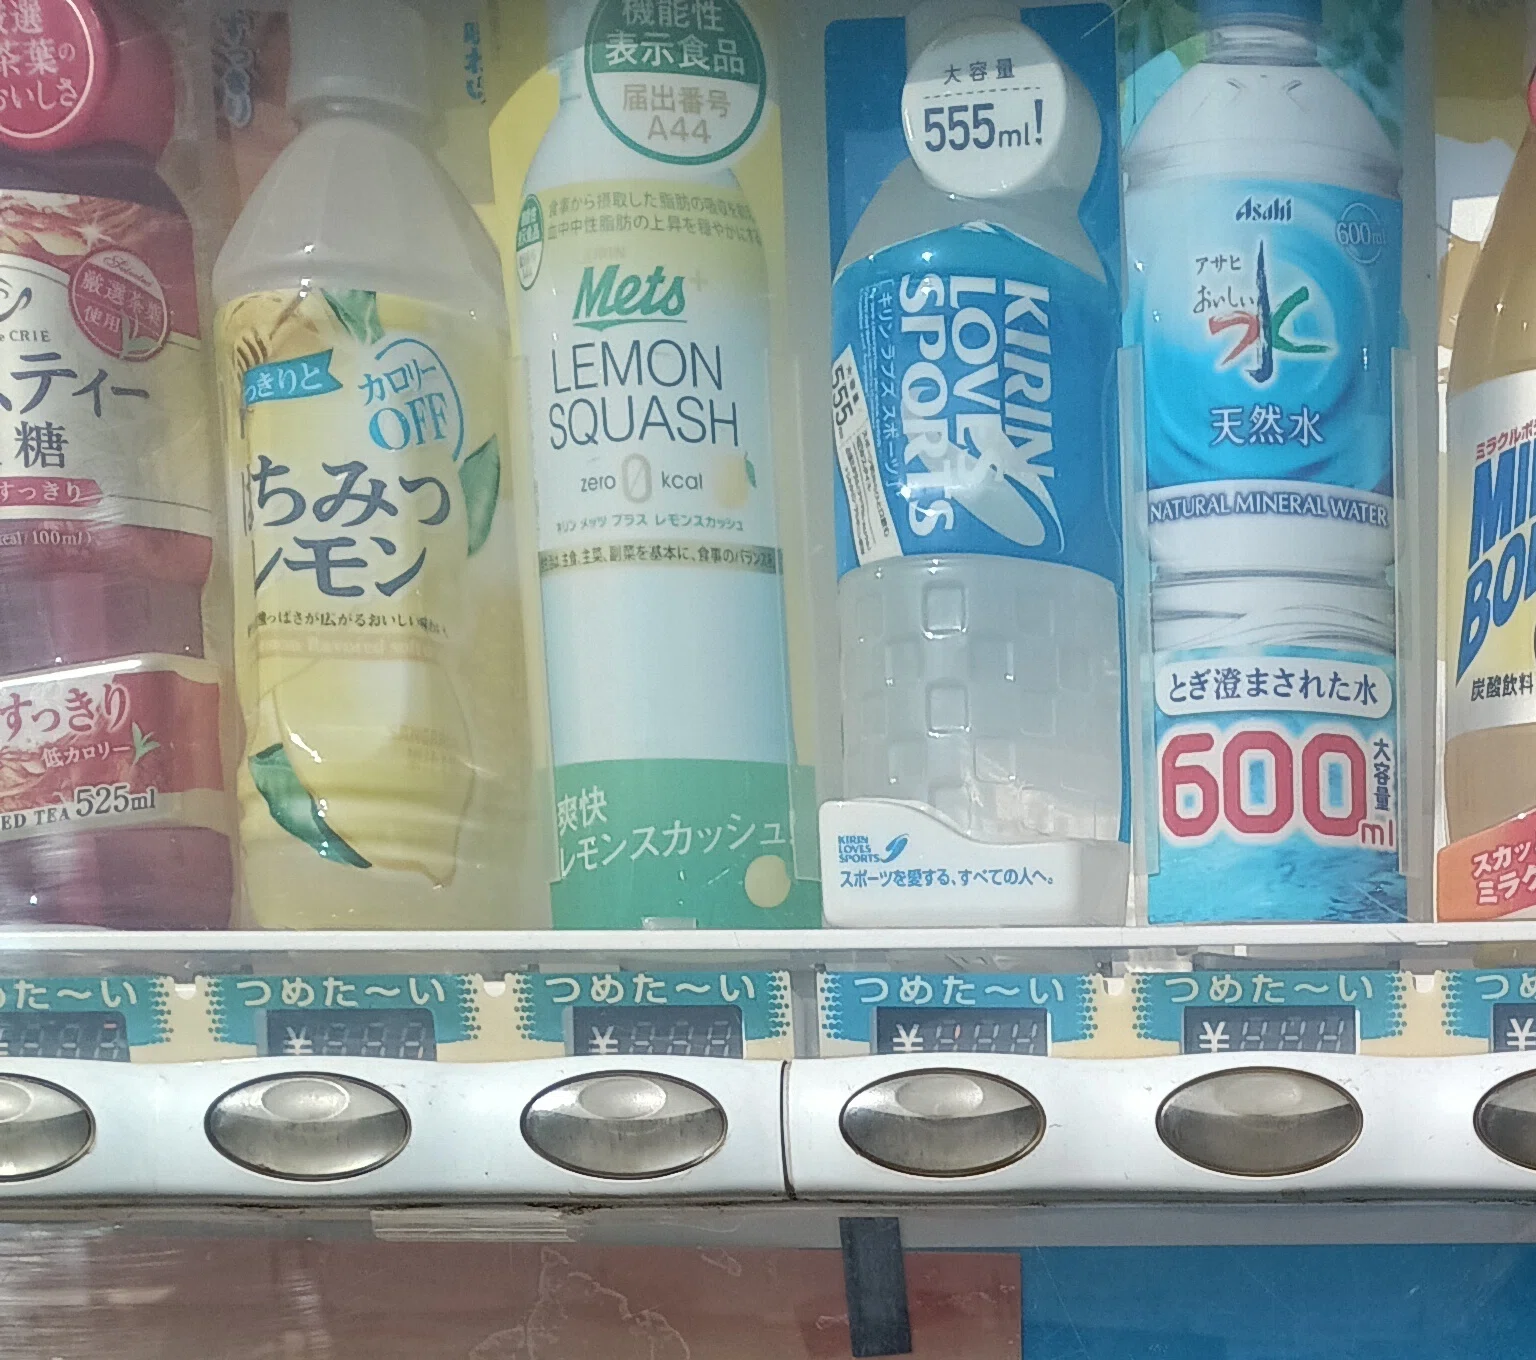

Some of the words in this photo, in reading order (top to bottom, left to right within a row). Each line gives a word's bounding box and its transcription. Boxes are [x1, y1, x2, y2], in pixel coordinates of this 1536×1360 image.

[605, 30, 745, 75] 表示食品
[943, 58, 1015, 84] 大容量
[647, 115, 712, 144] A44
[1235, 197, 1292, 222] Asahi
[1195, 254, 1242, 272] アサヒ
[572, 263, 686, 320] Mets
[551, 340, 724, 393] LEMON
[368, 392, 449, 451] OFF
[549, 395, 739, 450] SQUASH
[1210, 406, 1324, 448] 天然水
[580, 475, 616, 493] zero
[661, 471, 704, 490] kcal
[1150, 494, 1230, 523] NATURAL
[1233, 492, 1329, 516] MINERAL
[1332, 497, 1388, 527] WATER
[1168, 667, 1378, 704] とぎ澄まされた水
[1471, 672, 1533, 701] 炭酸飲料
[1373, 738, 1391, 812] 大容量
[33, 808, 70, 825] TEA
[75, 786, 155, 818] 525ml
[556, 786, 607, 833] 爽快
[560, 812, 785, 879] レモンスカッシュ
[838, 854, 880, 864] SPORTS
[840, 867, 1055, 888] スポーツを愛する、すべての人へ。
